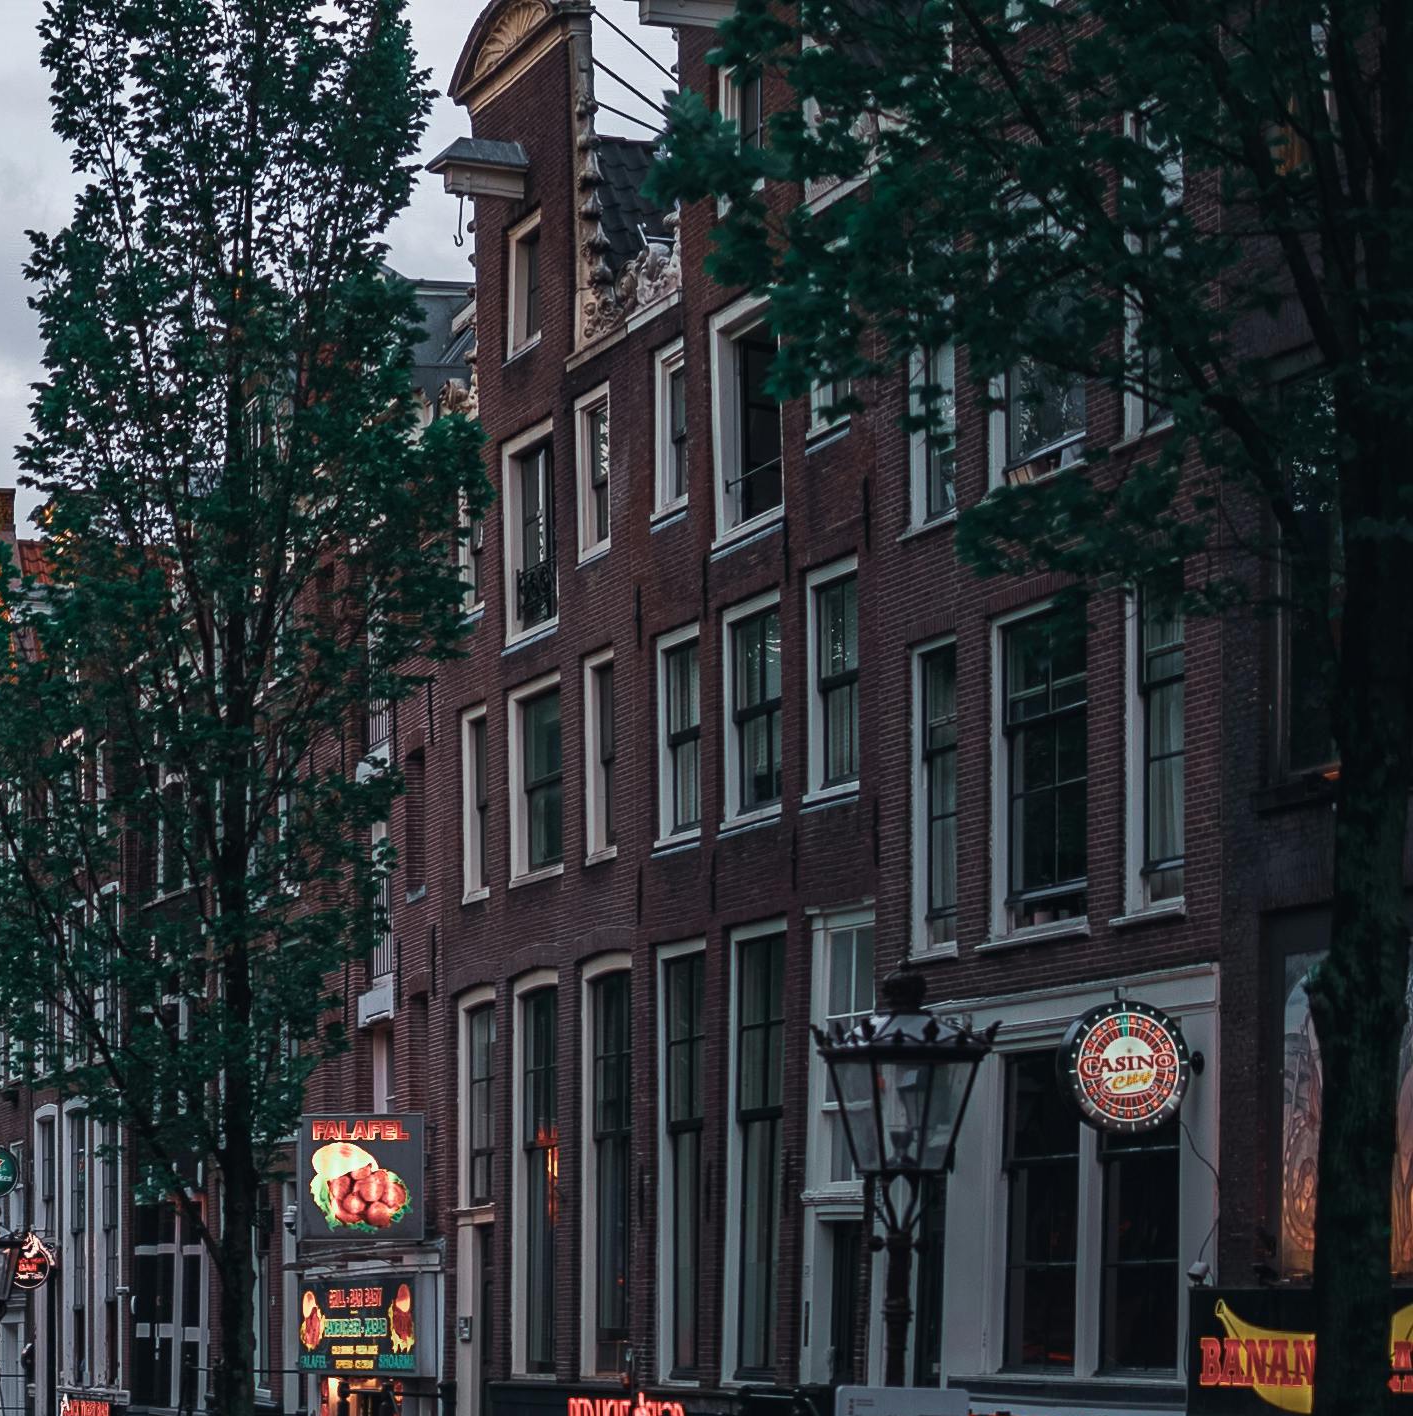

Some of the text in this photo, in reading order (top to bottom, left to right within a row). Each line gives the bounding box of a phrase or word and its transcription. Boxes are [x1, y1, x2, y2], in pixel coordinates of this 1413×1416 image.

[1079, 1053, 1176, 1080] CASINO
[1112, 1070, 1153, 1090] City
[312, 1119, 410, 1141] FALAFEL
[1199, 1336, 1317, 1389] BANAN
